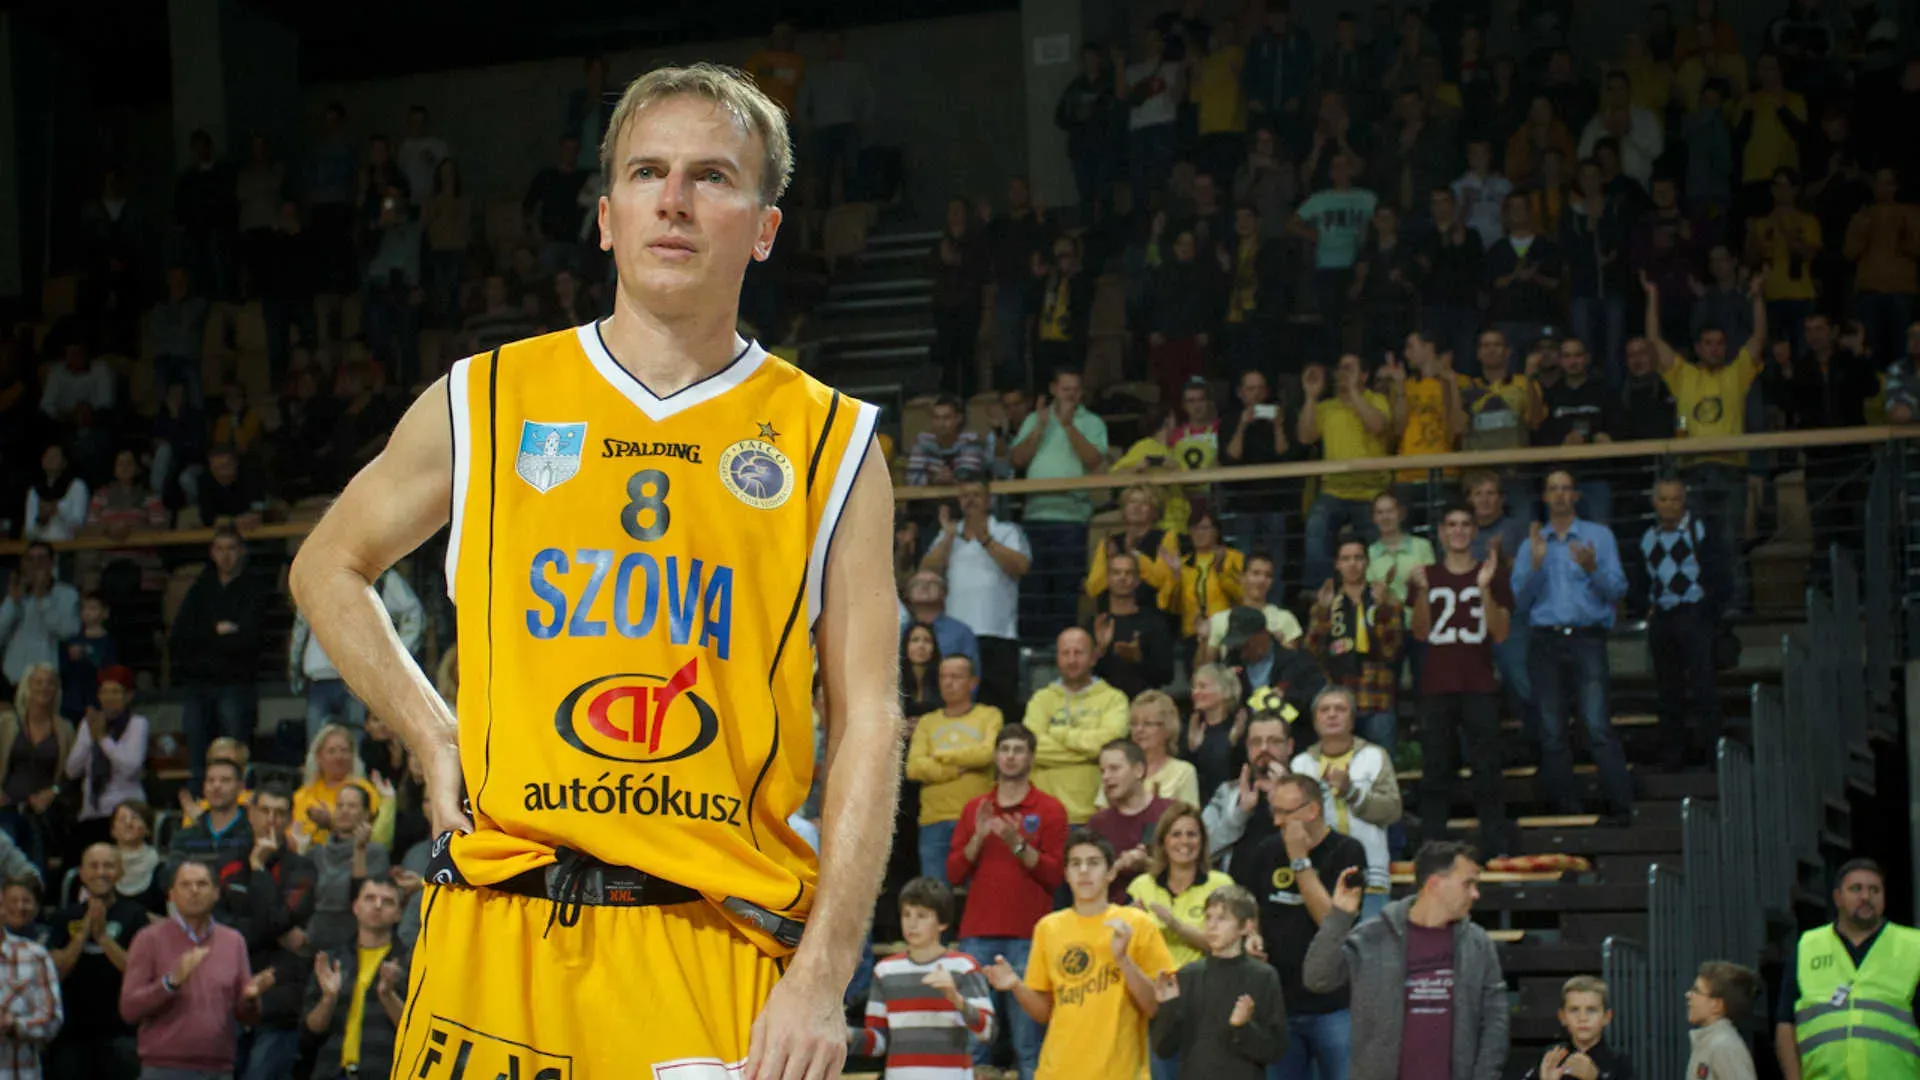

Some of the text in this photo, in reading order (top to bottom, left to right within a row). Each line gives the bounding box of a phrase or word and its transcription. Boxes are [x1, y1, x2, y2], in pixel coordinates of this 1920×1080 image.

[602, 439, 702, 464] SPALDING
[738, 440, 787, 464] FALCO
[620, 470, 670, 541] 8
[526, 548, 733, 660] SZOVA
[1428, 586, 1487, 645] 23
[524, 772, 741, 827] autófókusz
